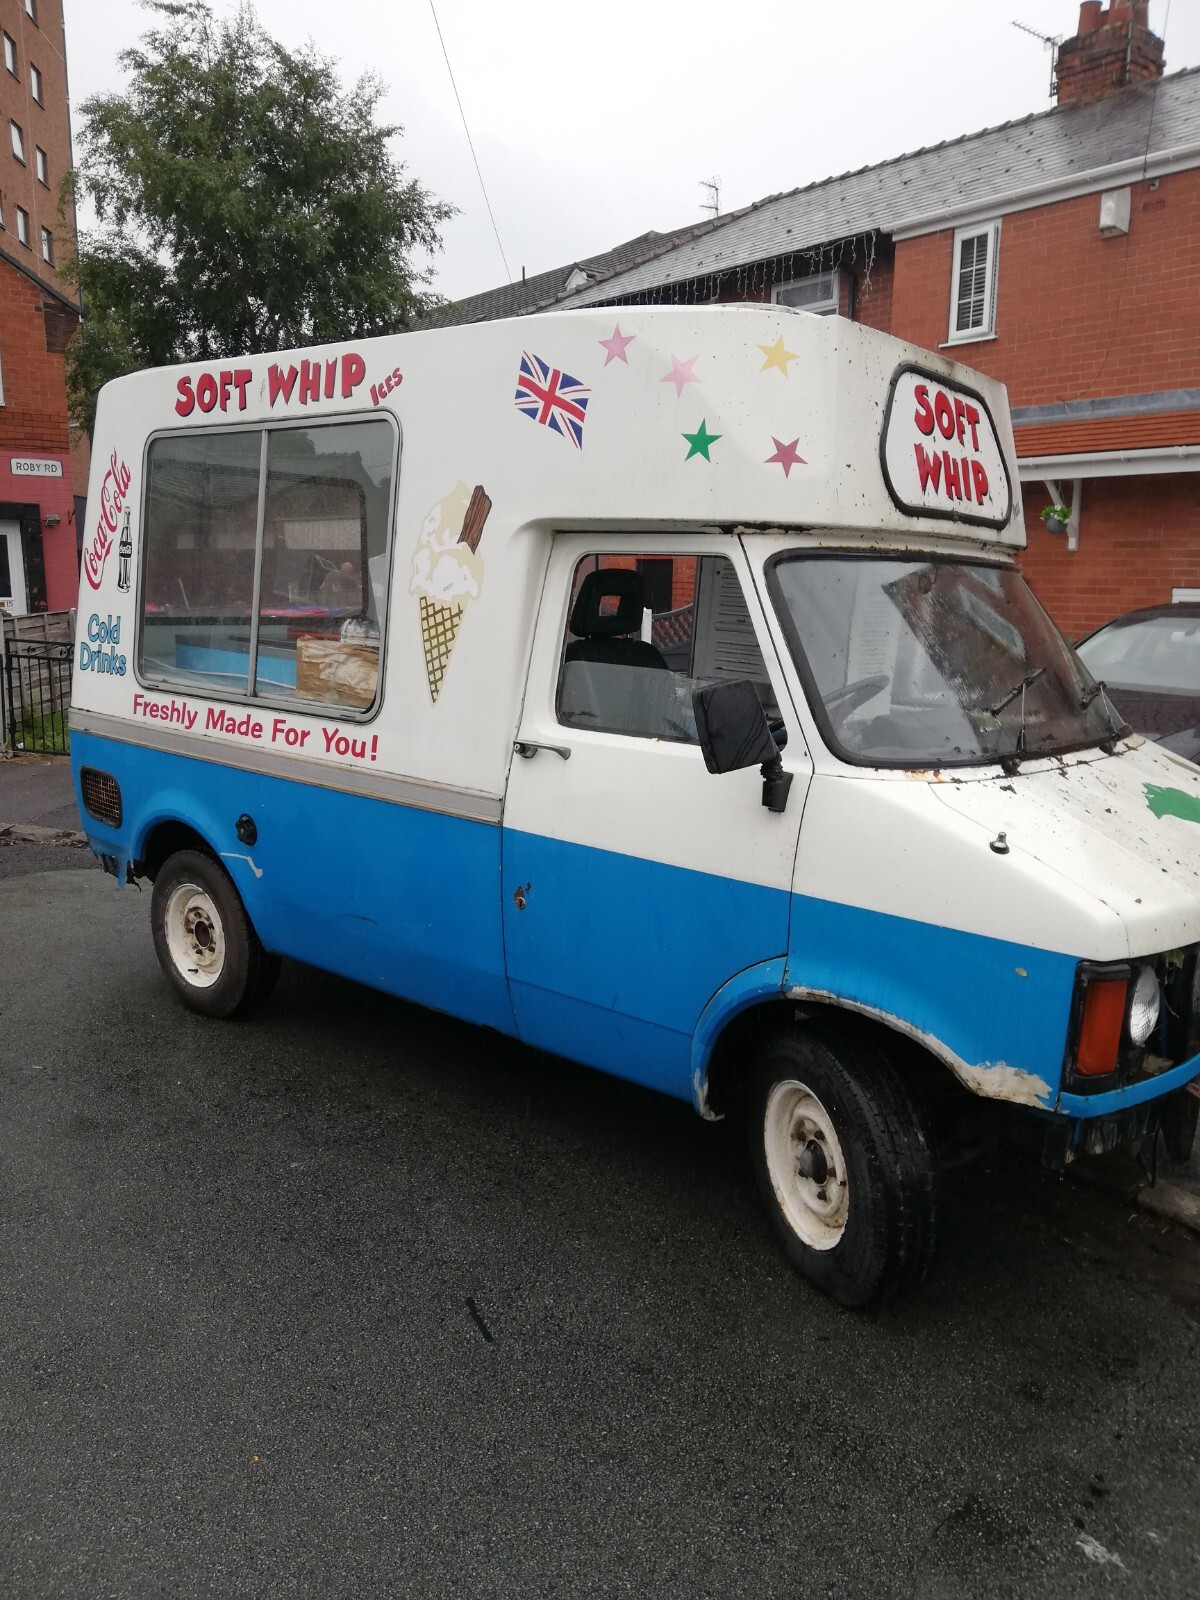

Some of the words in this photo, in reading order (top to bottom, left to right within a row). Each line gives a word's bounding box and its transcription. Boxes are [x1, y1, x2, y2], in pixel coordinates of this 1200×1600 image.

[175, 368, 252, 417] SOFT
[267, 352, 366, 409] WHIP
[369, 367, 404, 406] ICES
[913, 384, 980, 452] SOFT
[15, 462, 41, 472] ROBY
[44, 463, 58, 473] RD
[913, 442, 989, 506] WHIP
[79, 641, 127, 677] Drinks
[87, 613, 121, 644] Cold
[133, 693, 198, 730] Freshly
[205, 707, 264, 739] Made
[271, 718, 310, 747] For
[322, 727, 379, 762] You!
